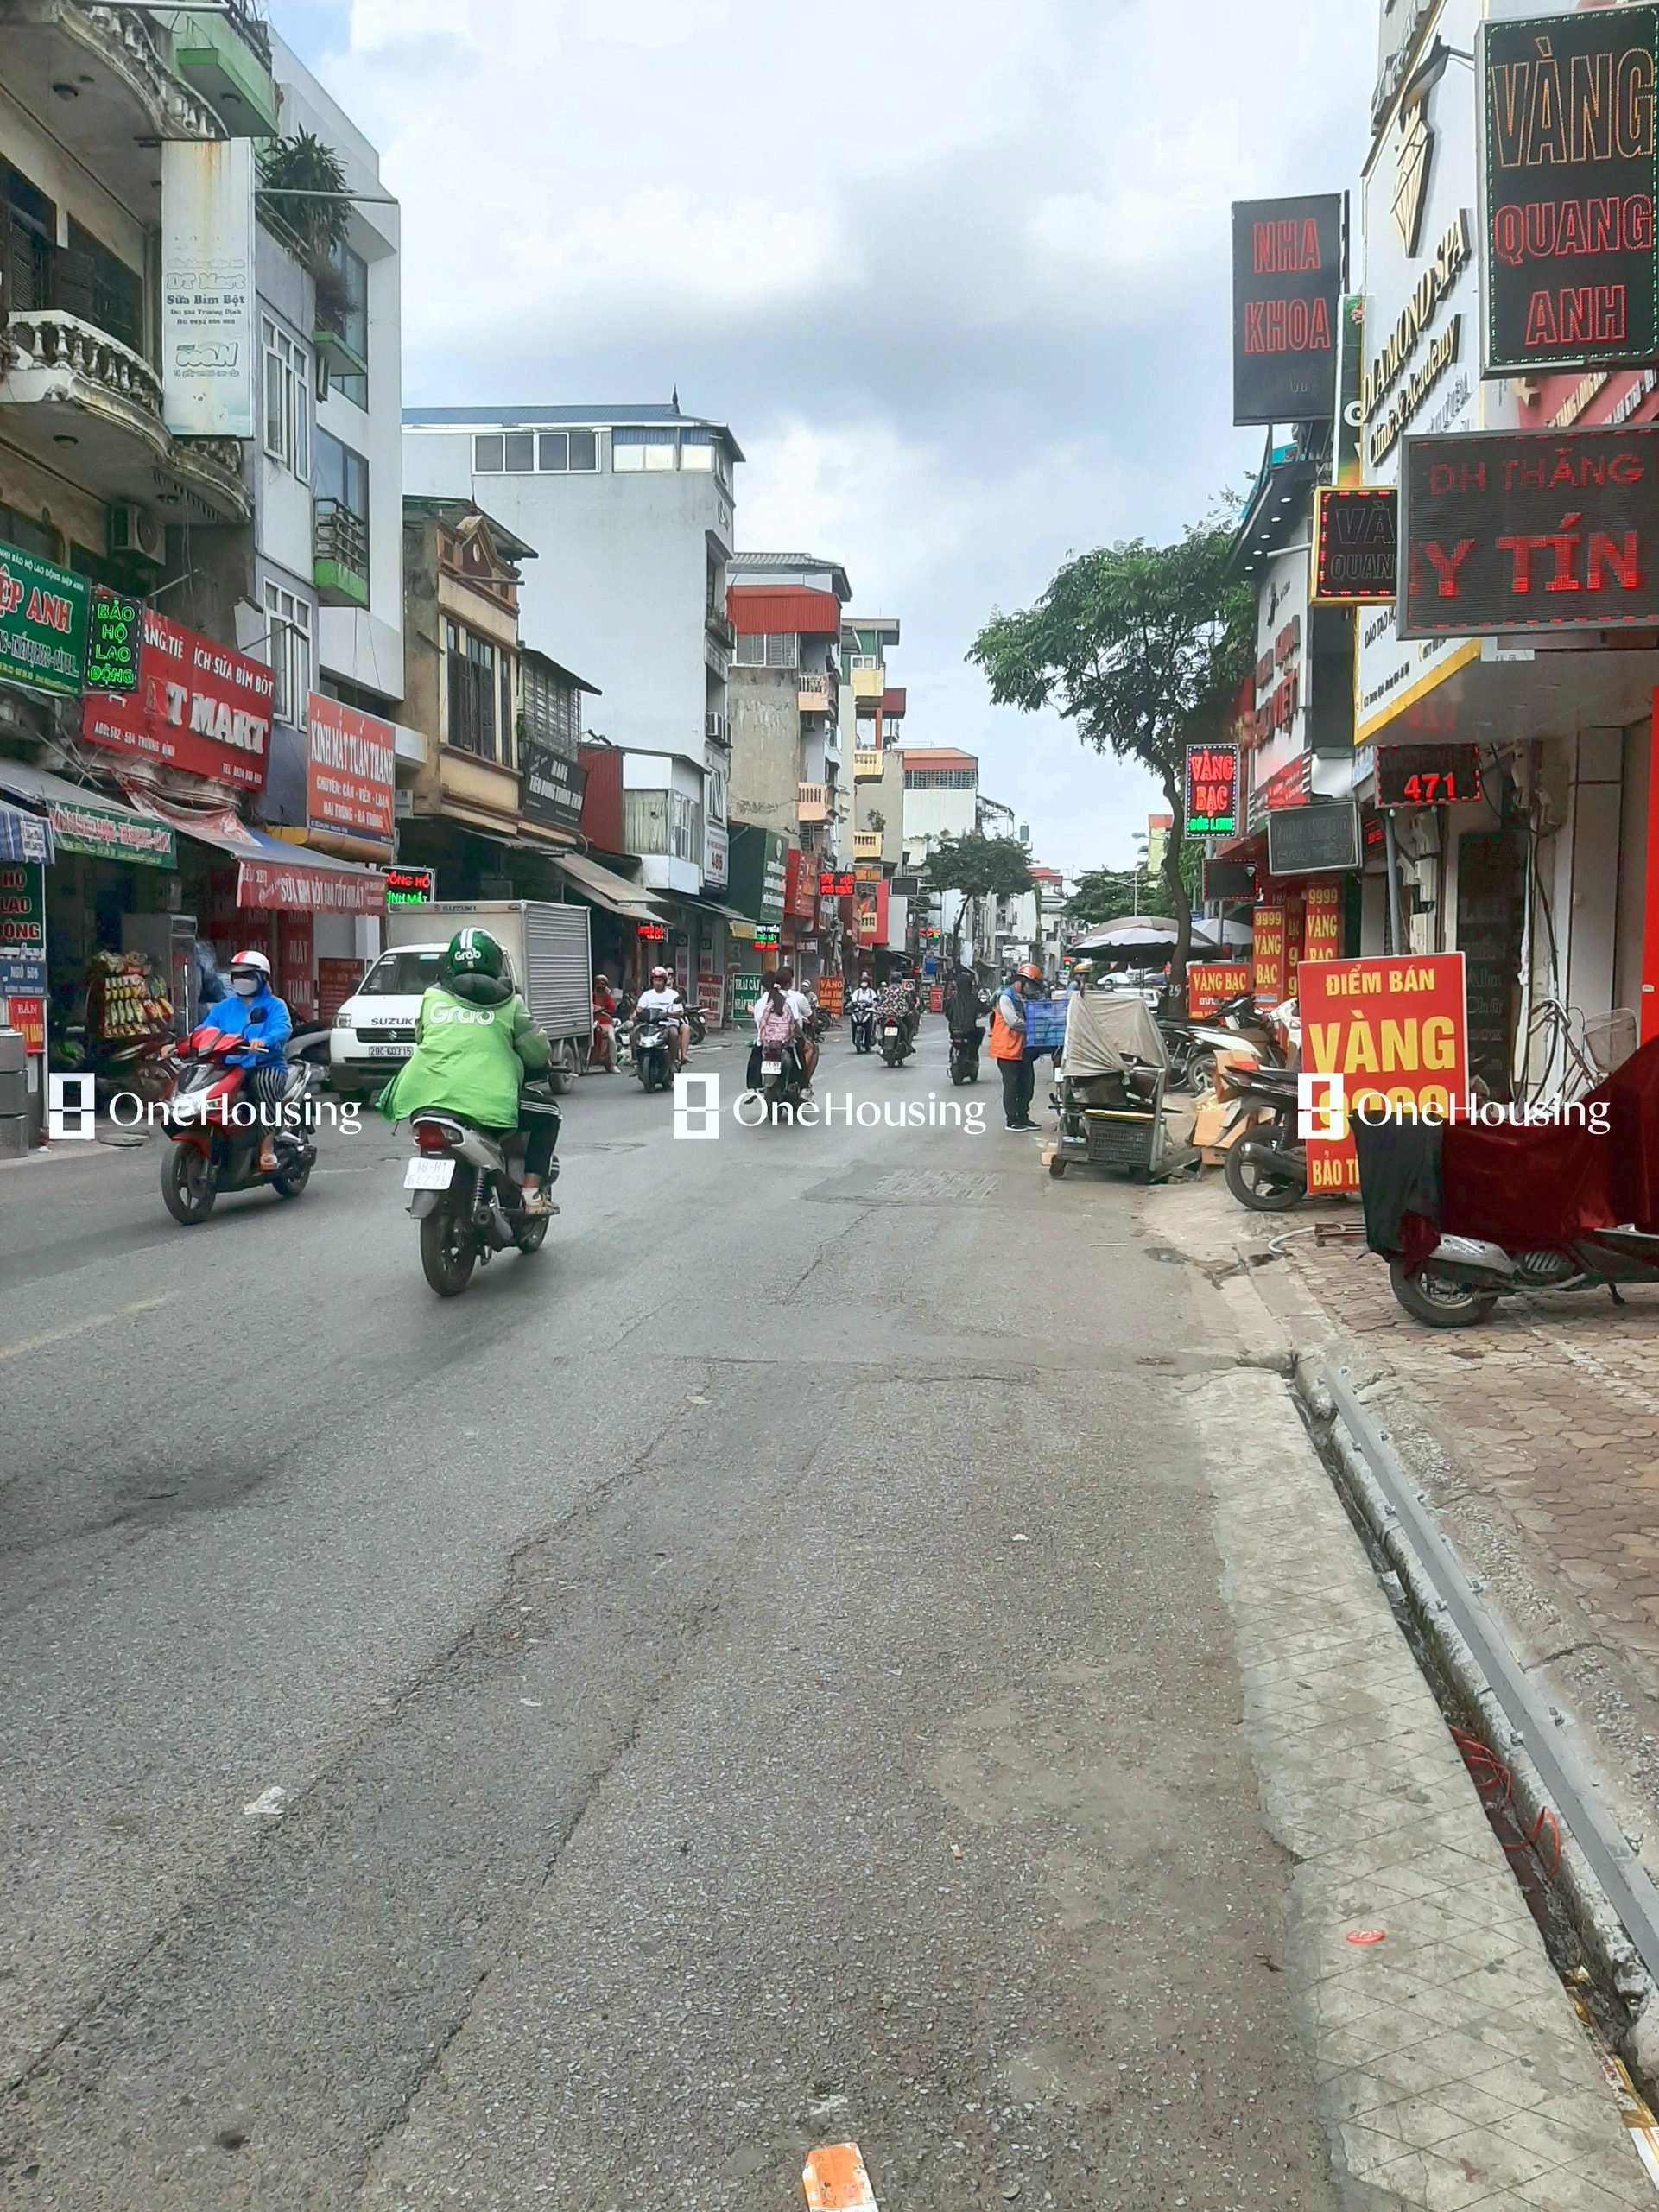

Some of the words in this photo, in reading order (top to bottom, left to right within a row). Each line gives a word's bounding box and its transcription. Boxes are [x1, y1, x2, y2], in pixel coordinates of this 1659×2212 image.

[1491, 36, 1655, 168] VÀNG
[1494, 193, 1654, 265] QUANG
[1252, 217, 1321, 275] NHA
[1243, 297, 1332, 355] KHOA
[1362, 267, 1437, 424] DIAMOND
[1435, 208, 1472, 301] SPA
[1524, 284, 1627, 347] ANH
[1405, 313, 1461, 419] Academy
[1335, 500, 1396, 545] VÀ
[1330, 551, 1397, 581] QUAN
[1496, 512, 1639, 594] TÍN
[26, 586, 73, 634] ANH
[97, 599, 136, 622] BẢO
[101, 622, 128, 644] HỘ
[95, 644, 131, 663] LAO
[90, 663, 135, 685] ĐỘNG
[189, 691, 269, 755] MART
[311, 708, 332, 769] KÍNH
[1191, 749, 1234, 782] VÀNG
[1195, 785, 1229, 817] BẠC
[1403, 771, 1456, 802] 471
[1308, 888, 1338, 905] 9999
[1255, 911, 1282, 927] 9999
[1307, 908, 1338, 938] VÀNG
[454, 948, 482, 961] Grab
[1254, 929, 1282, 955] VÀNG
[1193, 967, 1223, 992] VÀNG
[1225, 973, 1247, 995] BẠC
[1256, 963, 1278, 989] BẠC
[1325, 963, 1383, 997] ĐIỂM
[1389, 965, 1435, 993] BÁN
[17, 1001, 38, 1015] BÁN
[428, 1001, 496, 1026] Grab
[1308, 1009, 1457, 1075] VÀNG
[1312, 1150, 1343, 1188] BẢO
